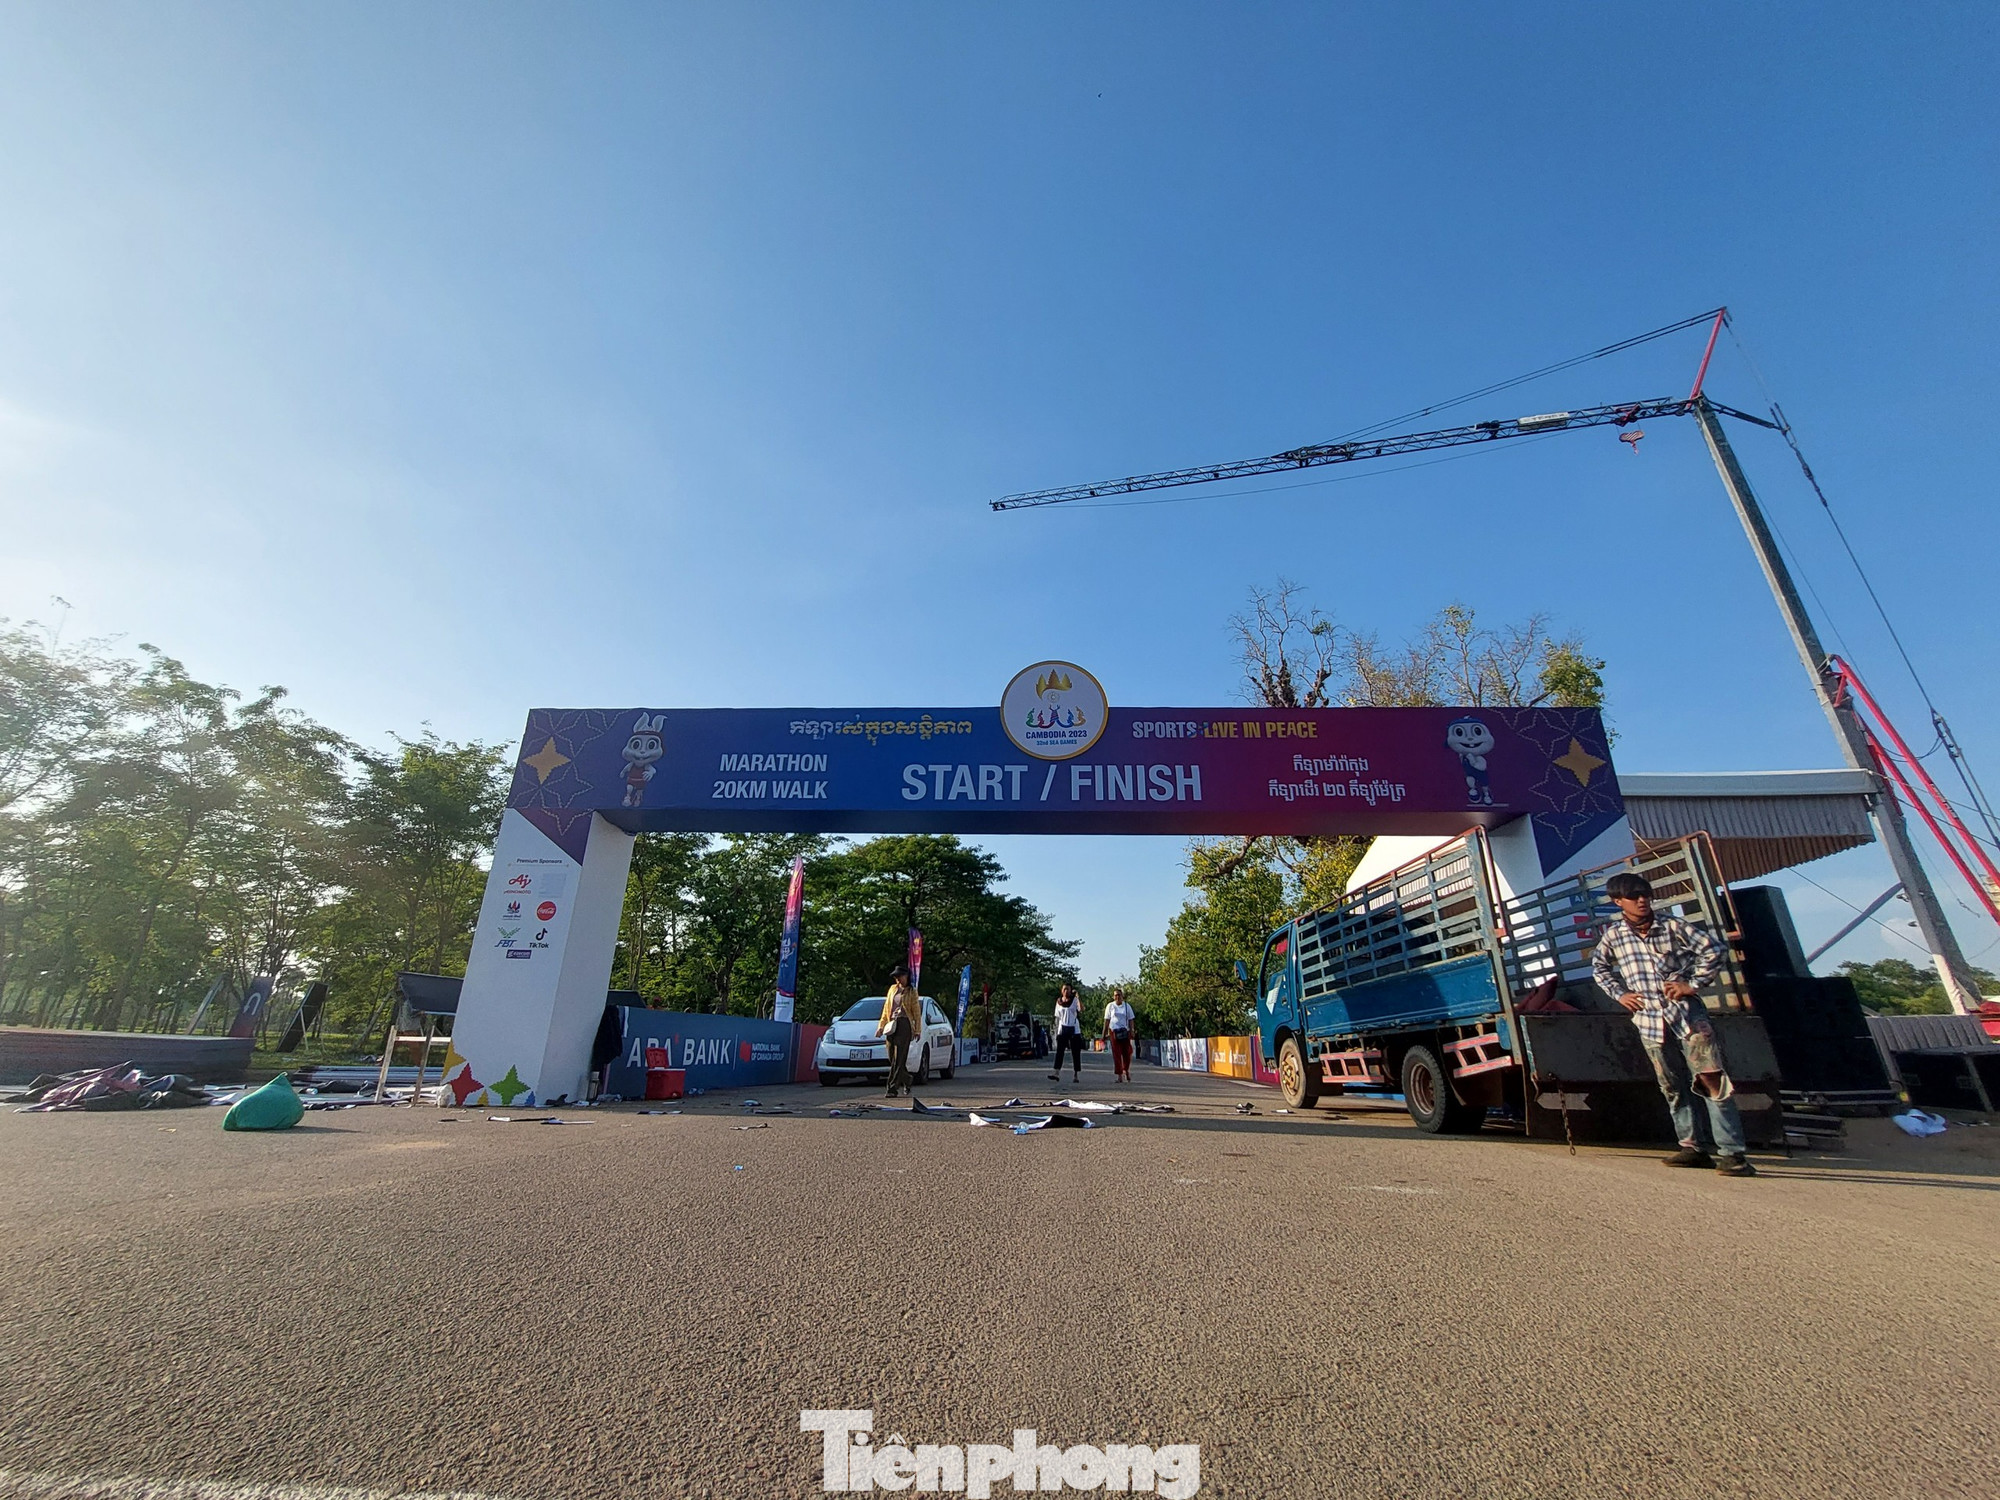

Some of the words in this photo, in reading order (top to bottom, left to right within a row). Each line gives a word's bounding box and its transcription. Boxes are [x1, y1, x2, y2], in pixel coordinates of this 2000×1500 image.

[1025, 730, 1067, 740] CAMBODIA
[1068, 729, 1088, 739] 2023
[1132, 721, 1197, 738] SPORTS
[1203, 721, 1239, 738] LIVE
[1243, 721, 1261, 738] IN
[1265, 721, 1318, 738] PEACE
[719, 754, 828, 772] MARATHON
[711, 780, 767, 799] 20KM
[772, 780, 829, 799] WALK
[901, 763, 1028, 801] START
[1039, 764, 1057, 801] /
[1070, 764, 1203, 801] FINISH
[682, 1038, 732, 1066] BANK
